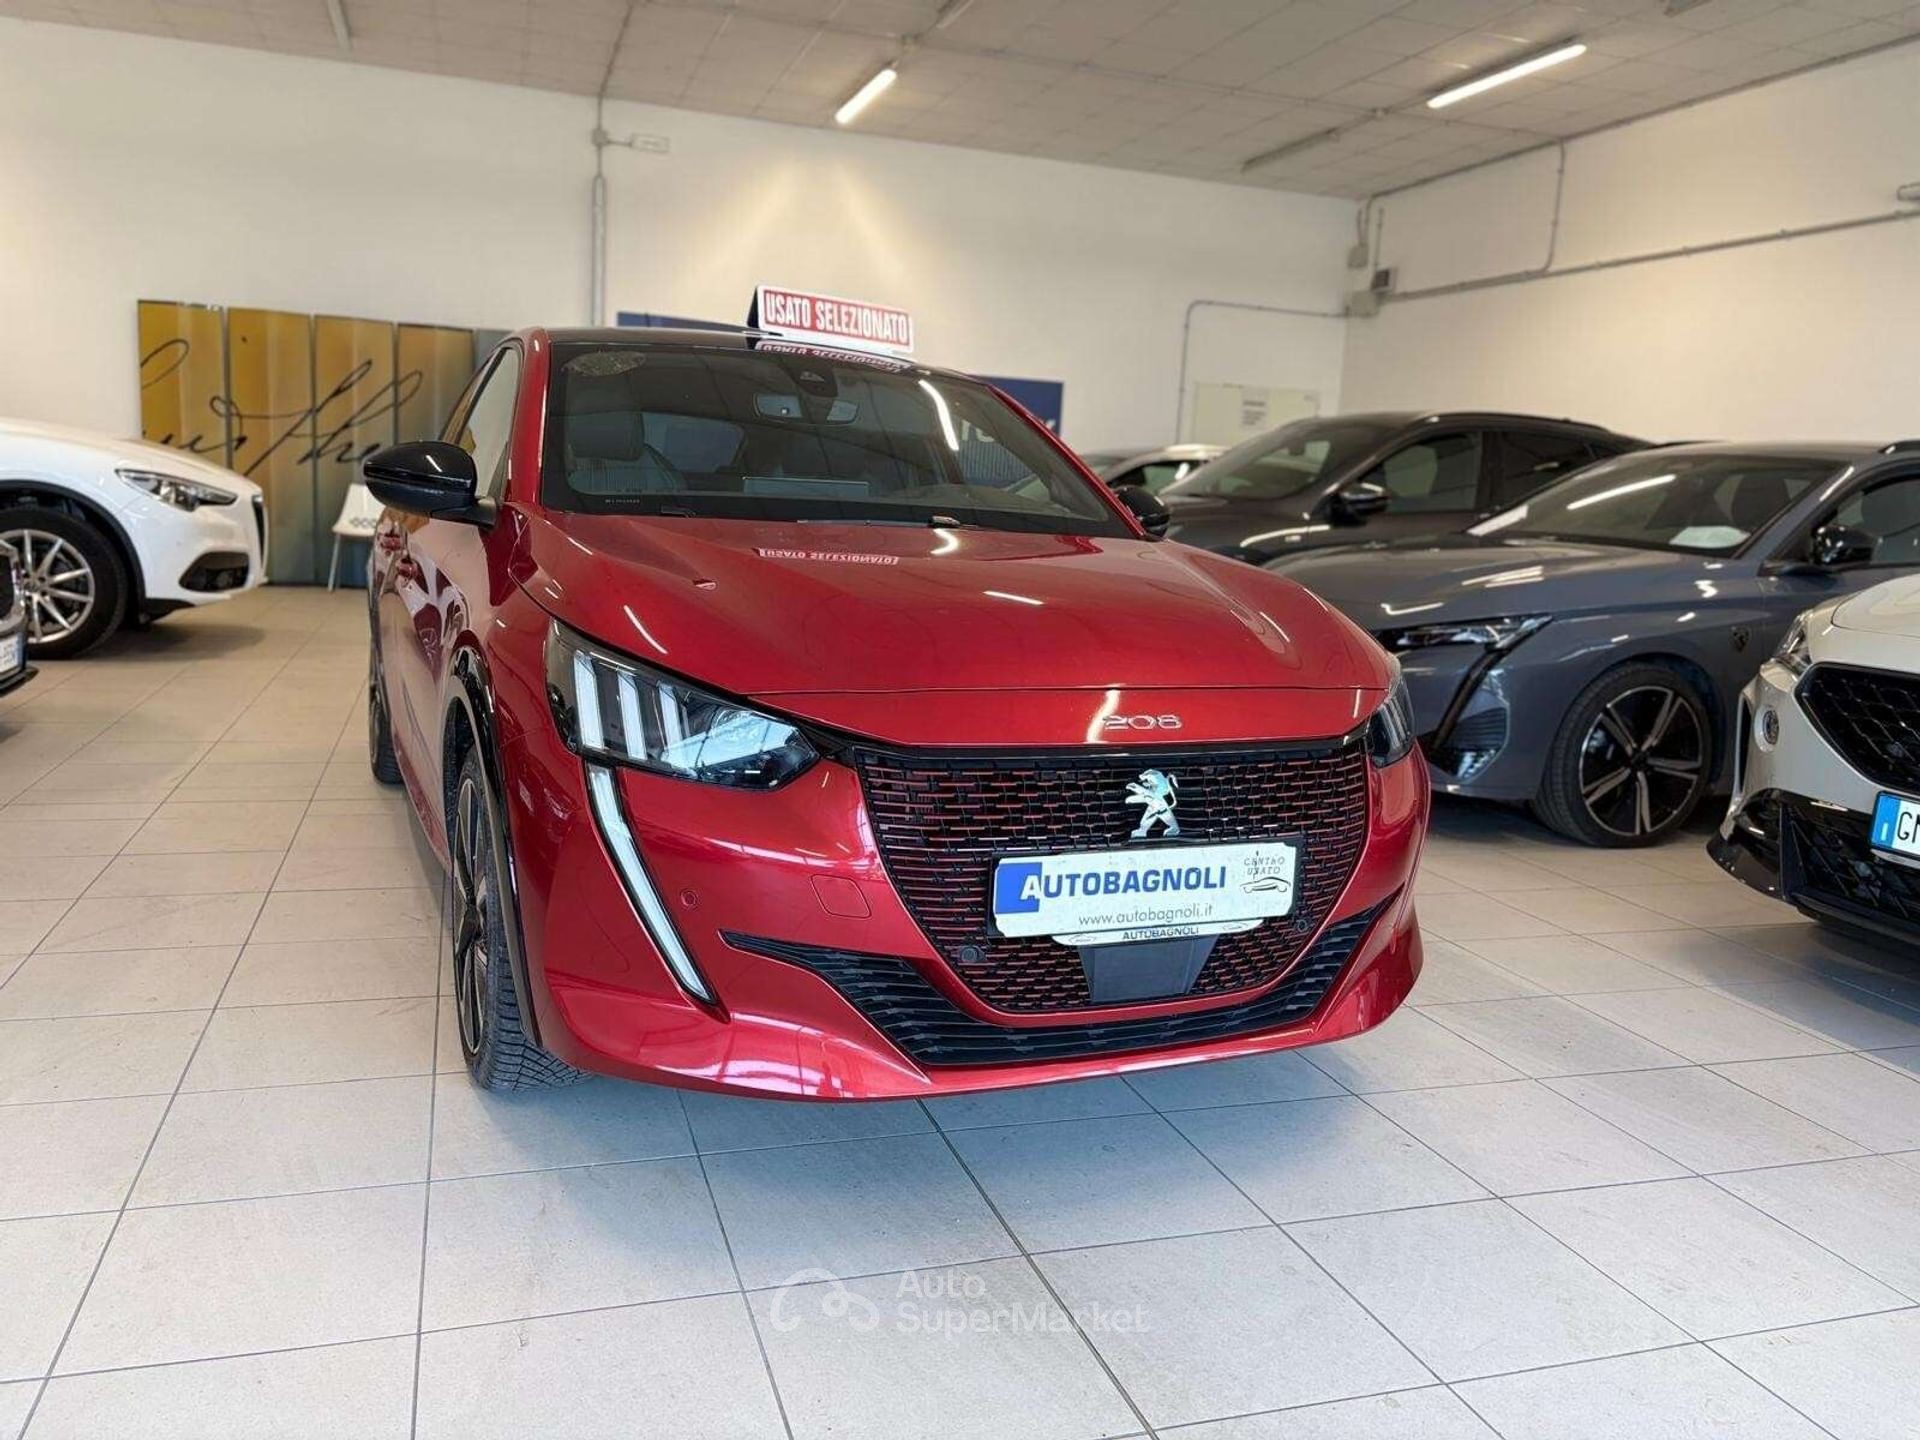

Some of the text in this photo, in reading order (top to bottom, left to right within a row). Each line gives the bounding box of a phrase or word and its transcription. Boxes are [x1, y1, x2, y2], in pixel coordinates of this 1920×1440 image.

[765, 292, 908, 346] USATO SELEZIONATO
[1104, 714, 1182, 731] 208
[1020, 866, 1227, 901] AUTOBAGNOLI
[1078, 902, 1213, 927] www.autobagnoli.it
[1122, 926, 1200, 941] AUTOBAGNOLI
